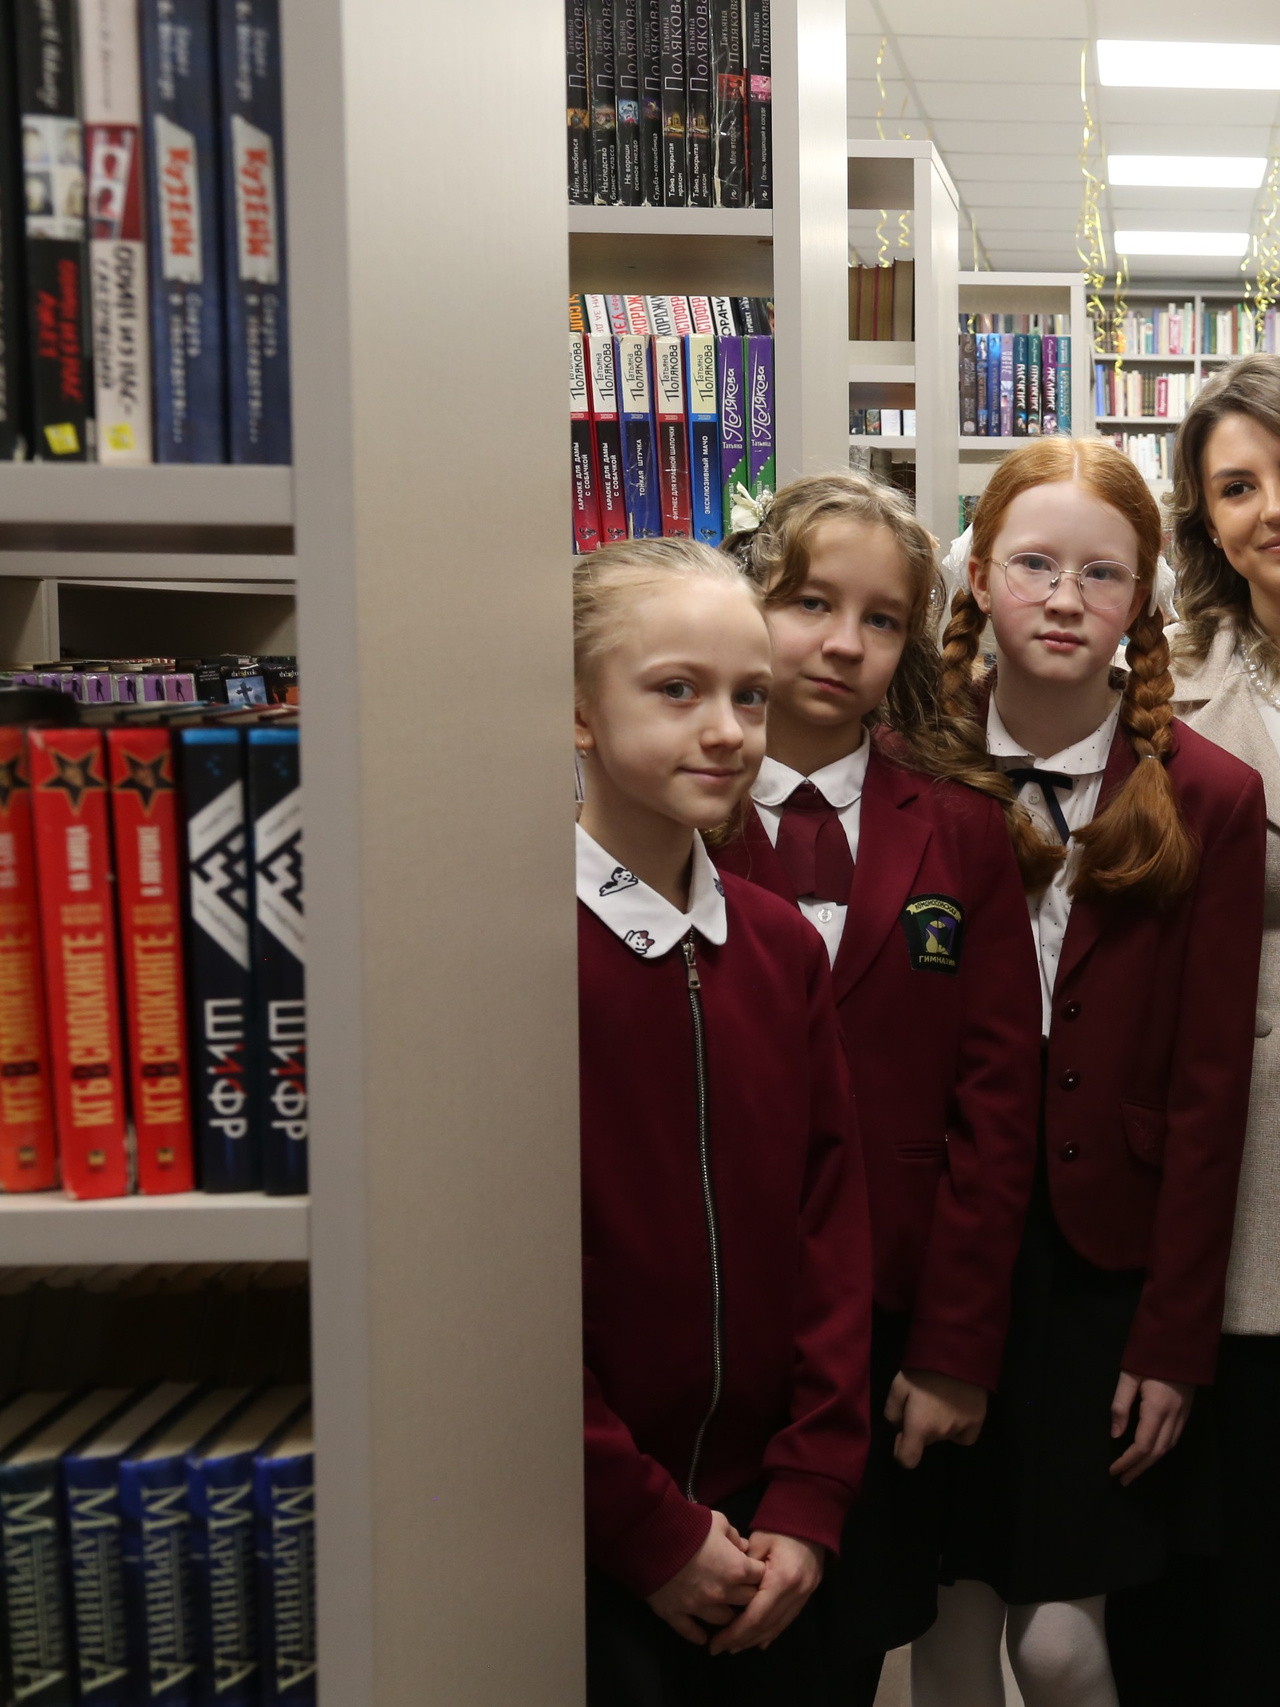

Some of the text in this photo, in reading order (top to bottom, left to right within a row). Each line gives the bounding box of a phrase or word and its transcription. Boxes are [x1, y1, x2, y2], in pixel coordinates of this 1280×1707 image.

[662, 17, 670, 56] Татьяна
[687, 18, 696, 57] Татьяна
[720, 10, 728, 47] Татьяна
[752, 12, 760, 49] Татьяна
[600, 147, 609, 192] Наследство
[624, 174, 630, 184] Не
[571, 342, 585, 399] Полякова
[593, 353, 604, 385] Татьяна
[601, 343, 613, 400] Полякова
[624, 353, 635, 386] Татьяна
[633, 344, 645, 401] Полякова
[658, 354, 669, 386] Татьяна
[667, 345, 679, 402] Полякова
[694, 354, 704, 387] Татьяна
[702, 345, 714, 402] Полякова
[722, 352, 743, 441] Полякова
[751, 351, 772, 440] Полякова
[582, 454, 590, 489] СОБАЧКОЙ
[602, 442, 610, 463] ДАМЫ
[610, 455, 619, 489] СОБАЧКОЙ
[669, 456, 677, 483] КРАСНОЙ
[637, 470, 645, 496] ТОНКАЯ
[703, 458, 711, 514] ЭКСКЛЮЗИВНЫЙ
[671, 497, 679, 520] ФИТНЕС
[919, 955, 956, 967] ГИМНАЗИЯ
[62, 933, 114, 1127] КГБ СМОКИНГЕ
[133, 933, 183, 1125] КГБ СМОКИНГЕ
[204, 999, 247, 1138] ШИФР
[269, 1000, 308, 1139] ШИФР
[2, 1081, 42, 1125] КГБ
